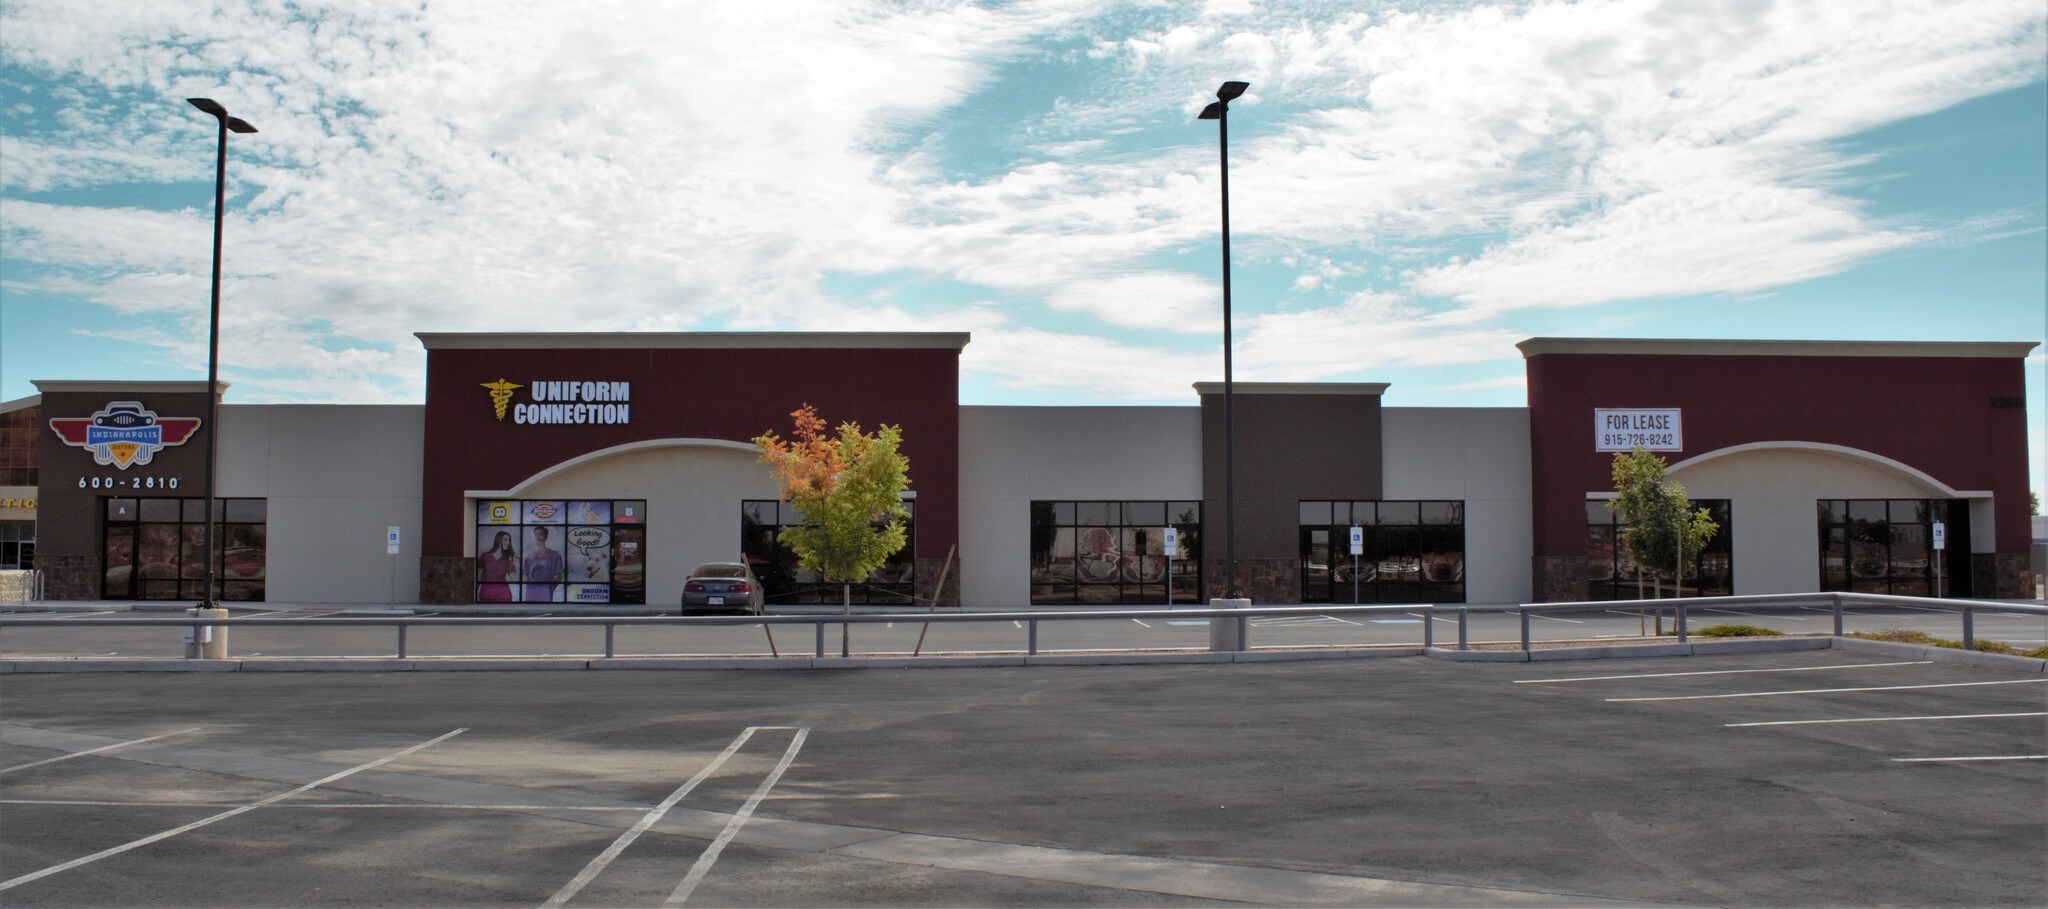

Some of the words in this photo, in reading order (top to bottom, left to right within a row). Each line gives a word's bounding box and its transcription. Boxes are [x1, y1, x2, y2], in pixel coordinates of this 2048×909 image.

[531, 381, 630, 402] UNIFORM
[513, 403, 630, 425] CONNECTION
[1607, 415, 1629, 430] FOR
[1633, 415, 1670, 430] LEASE
[92, 431, 157, 439] INDIANAPOLIS
[1604, 433, 1673, 445] 915-726-8242
[625, 508, 633, 516] B
[574, 529, 602, 538] Looking
